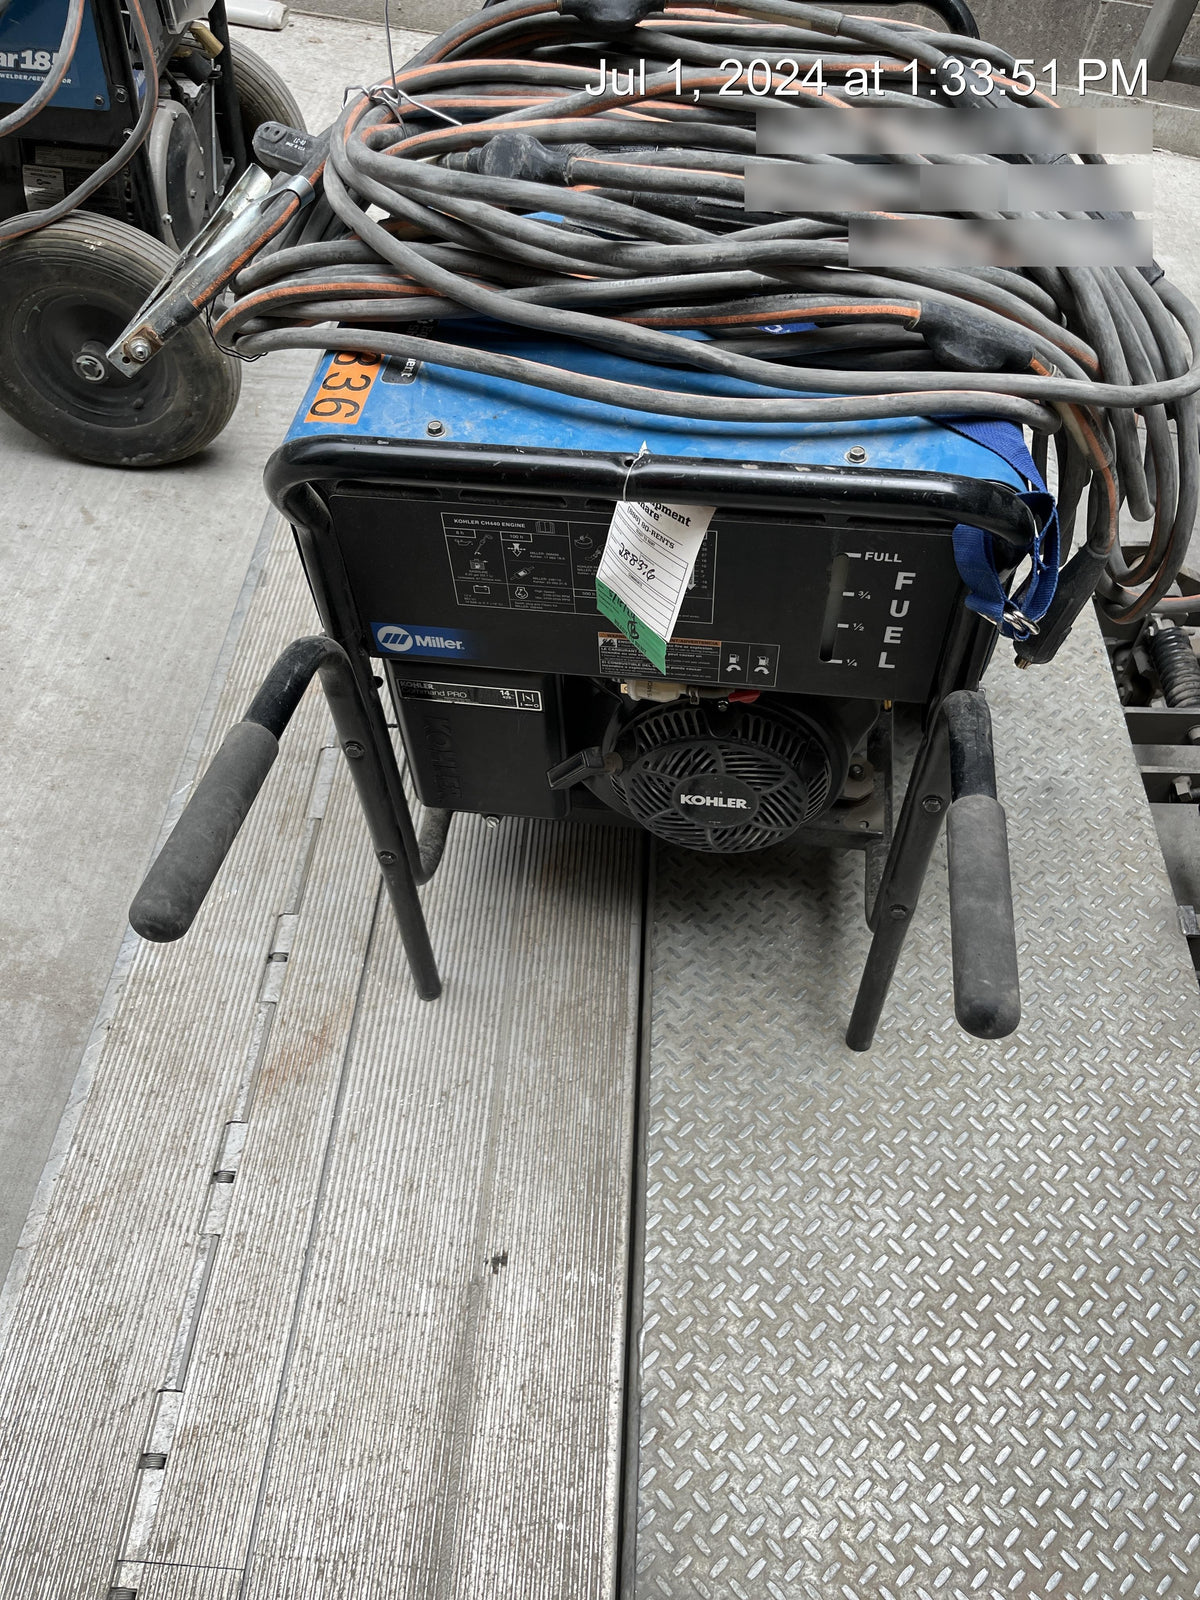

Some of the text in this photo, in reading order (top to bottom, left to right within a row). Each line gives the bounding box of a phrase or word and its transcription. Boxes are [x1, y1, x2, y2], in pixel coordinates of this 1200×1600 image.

[453, 518, 480, 526] KOHLER
[864, 551, 903, 563] FULL
[878, 571, 916, 669] FUEL
[415, 635, 463, 650] Miller
[400, 680, 434, 691] KOHLER
[447, 690, 468, 699] PRO
[680, 793, 747, 810] KOHLER
